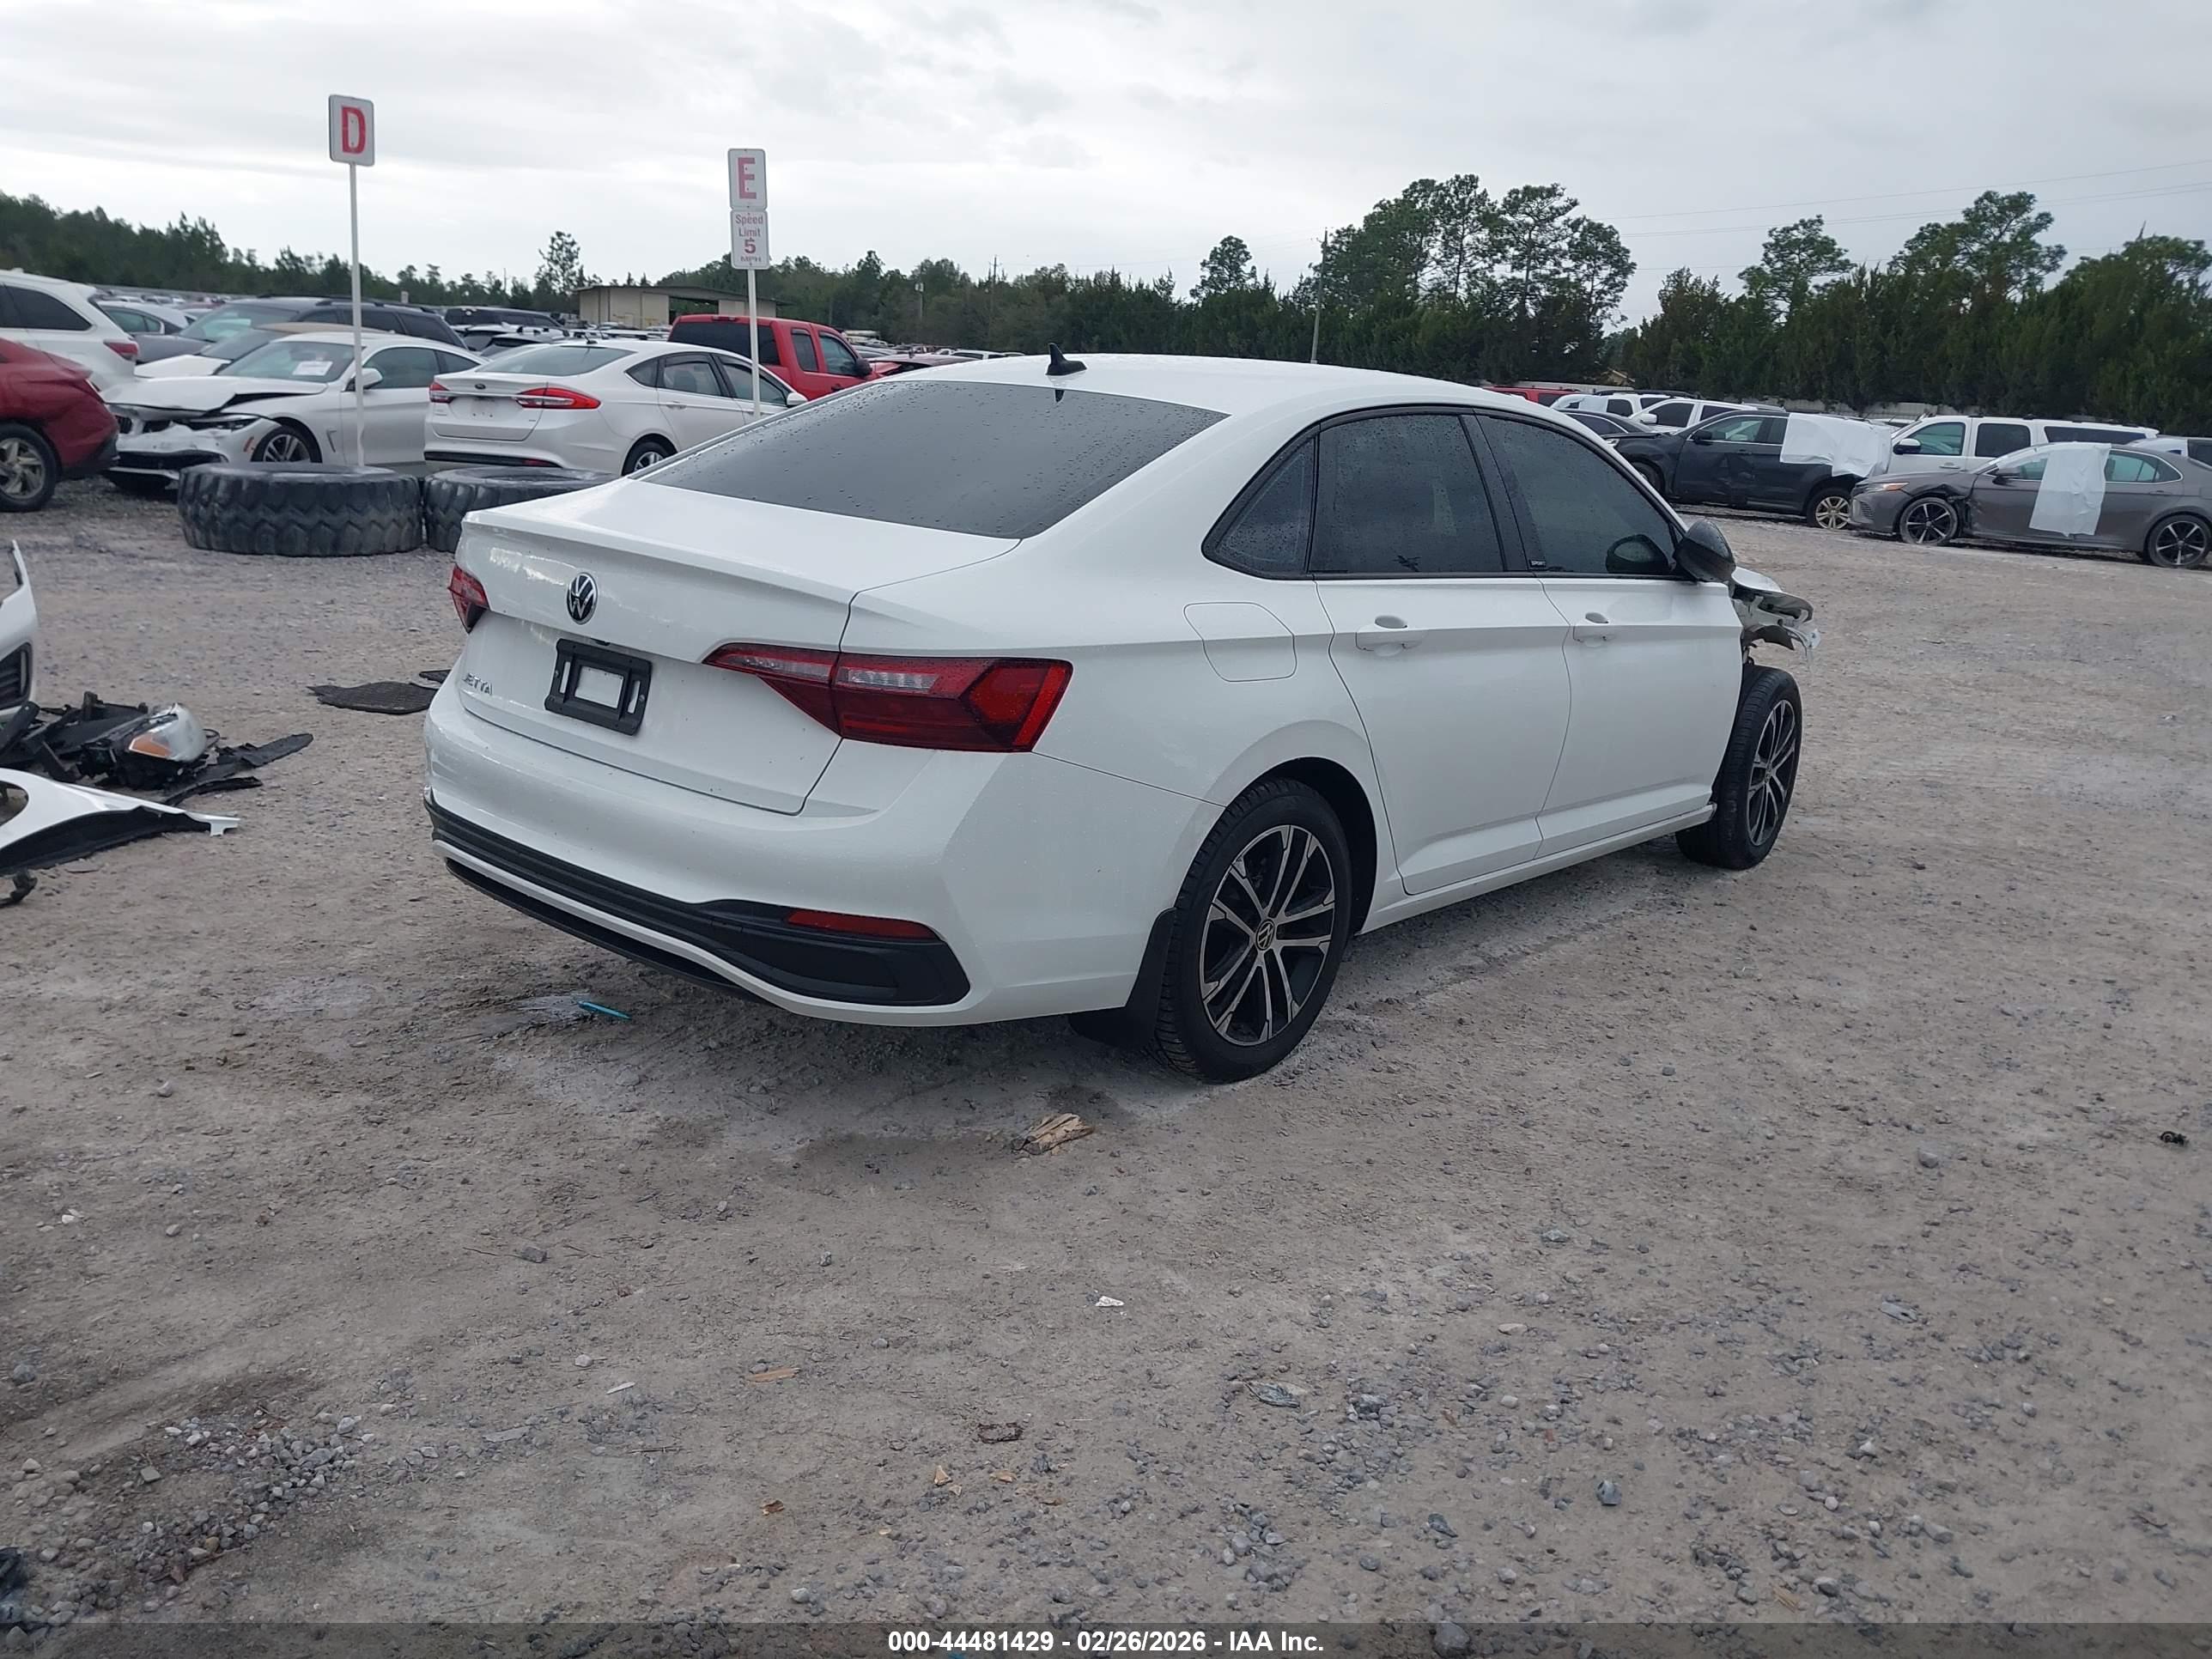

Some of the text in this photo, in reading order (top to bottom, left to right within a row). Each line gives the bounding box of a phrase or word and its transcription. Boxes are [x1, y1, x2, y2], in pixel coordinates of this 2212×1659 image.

[341, 106, 366, 154] D
[737, 157, 757, 199] E
[736, 214, 763, 226] Speed
[738, 228, 761, 238] Limit
[744, 239, 757, 254] 5
